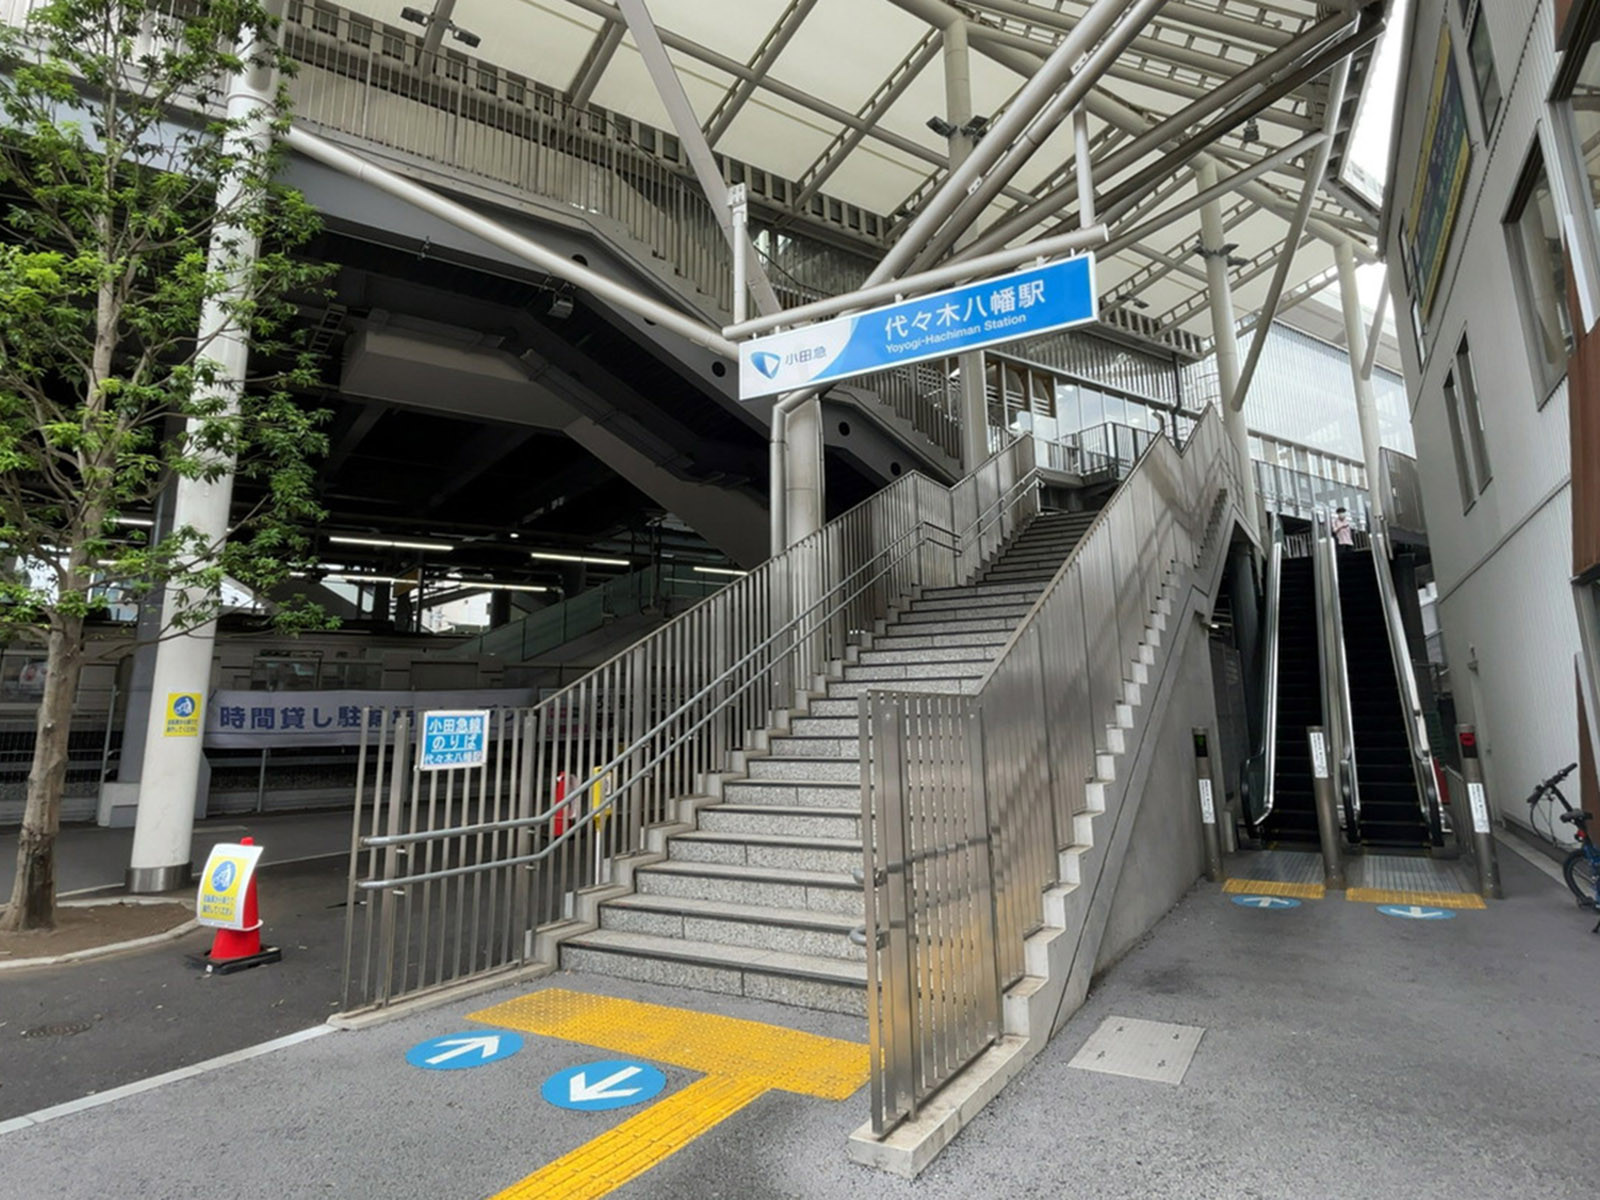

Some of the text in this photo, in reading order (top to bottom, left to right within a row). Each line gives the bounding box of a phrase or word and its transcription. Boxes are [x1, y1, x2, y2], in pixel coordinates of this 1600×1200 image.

[885, 279, 1046, 341] 代々木八幡駅
[885, 313, 1027, 354] Yoyogi-Hachiman Station
[785, 345, 827, 366] 小田急
[432, 734, 477, 751] のりば
